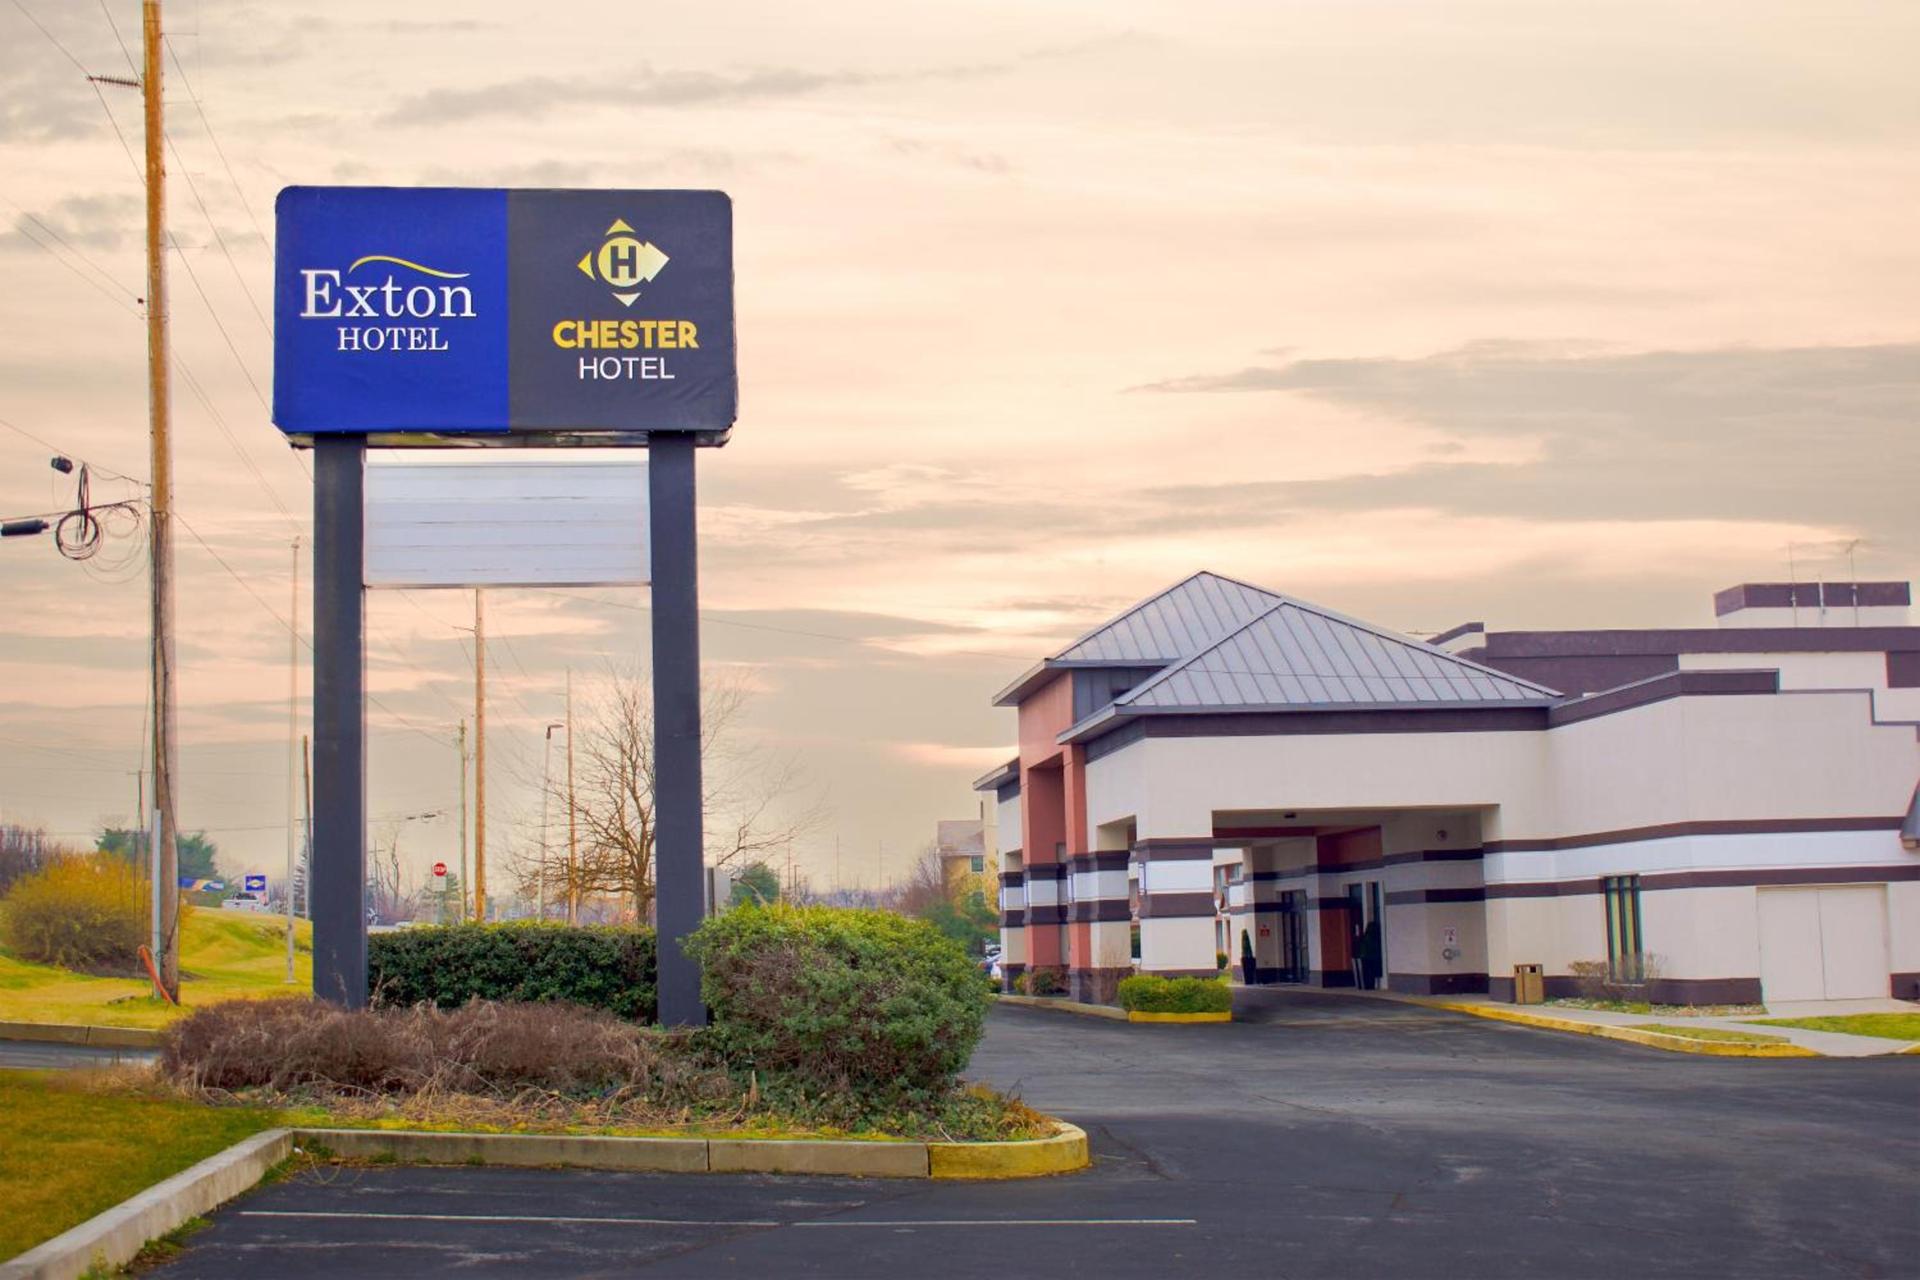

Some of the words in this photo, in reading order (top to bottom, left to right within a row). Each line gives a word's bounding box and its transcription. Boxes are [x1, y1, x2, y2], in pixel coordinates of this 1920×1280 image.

[610, 245, 637, 280] H
[300, 269, 477, 318] Exton
[337, 327, 449, 351] HOTEL
[552, 320, 699, 349] CHESTER
[579, 356, 675, 380] HOTEL
